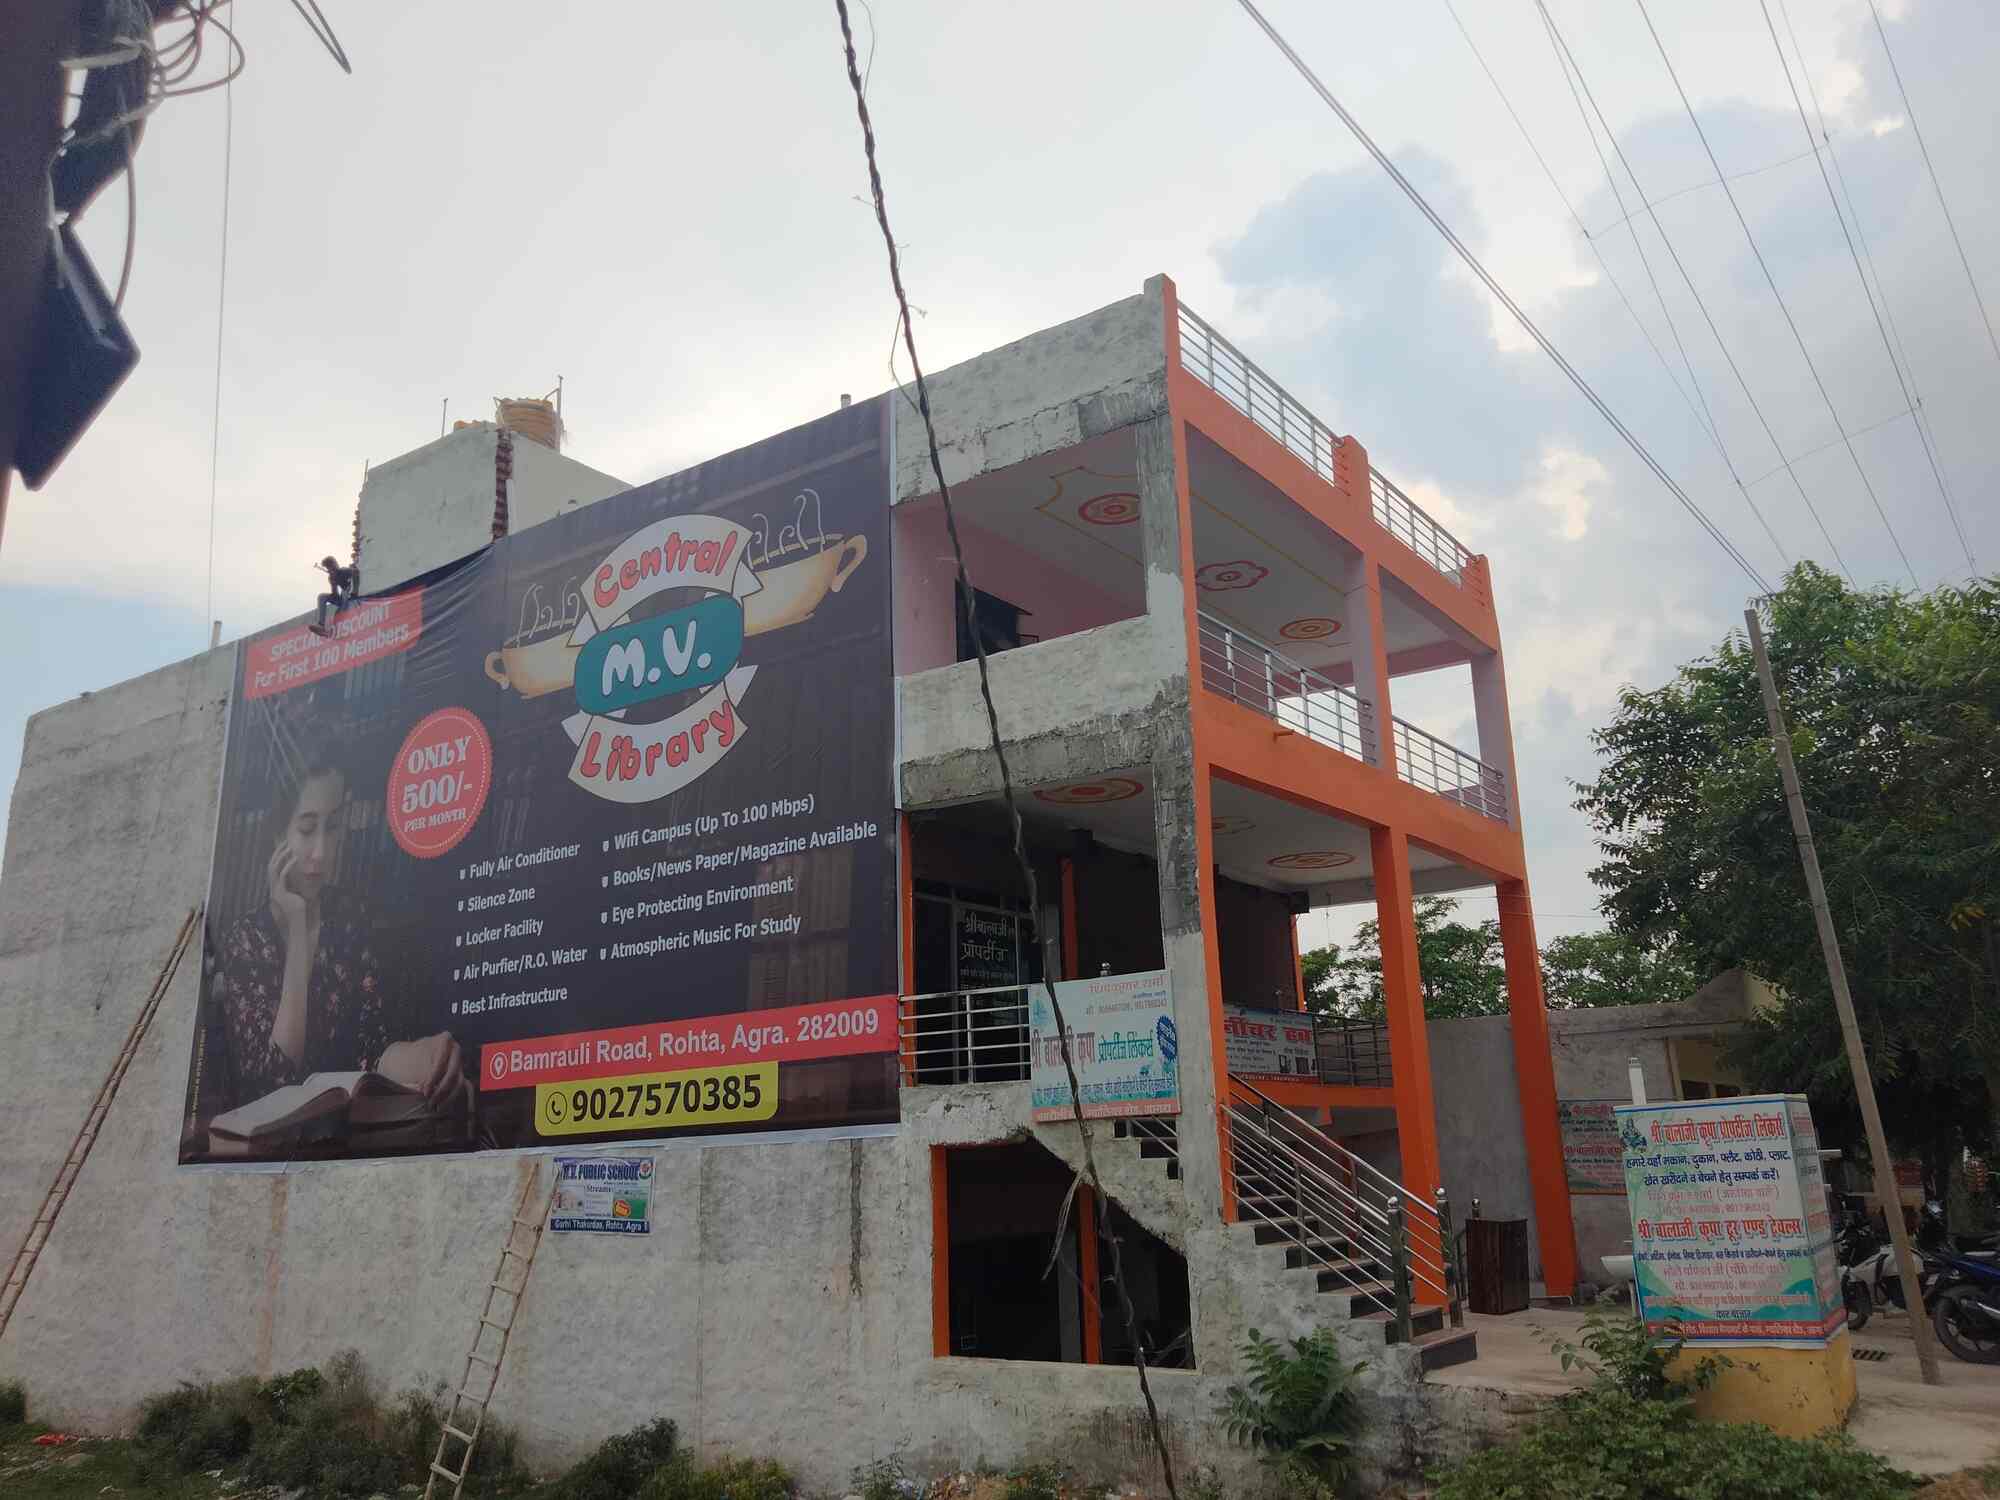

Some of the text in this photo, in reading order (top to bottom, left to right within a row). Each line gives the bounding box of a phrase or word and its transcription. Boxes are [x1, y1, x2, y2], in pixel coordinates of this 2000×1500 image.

[593, 531, 737, 608] Central
[254, 623, 409, 690] For First 100 Members
[602, 620, 712, 696] M.V.
[407, 736, 472, 774] ONLY
[580, 700, 736, 781] Library
[402, 771, 473, 813] 500/-
[404, 808, 467, 833] PER MONTH
[614, 794, 815, 850] Wifi Campus (Up To 100 Mbps)
[469, 843, 581, 880] Fully Air Conditioner
[613, 821, 878, 887] Books/News Paper/Magazine Available
[467, 887, 536, 912] Silence Zone
[612, 876, 795, 925] Eye Protecting Environment
[465, 918, 544, 946] Locker Facility
[610, 914, 801, 960] Atmospheric Music For Study
[463, 965, 480, 981] Air
[551, 947, 588, 966] Water
[461, 986, 568, 1015] Best Infrastructure
[510, 1009, 879, 1073] Bamrauli Road, Rohta, Agra. 282009
[572, 1074, 762, 1122] 9027570385
[1651, 1118, 1662, 1144] श्री
[1664, 1117, 1697, 1143] बालाजी
[1699, 1121, 1717, 1147] कृपा
[578, 1163, 606, 1180] PUBLIC
[607, 1163, 640, 1181] SCHOOL
[1626, 1153, 1645, 1169] हमारे
[1661, 1171, 1689, 1185] खरीदने
[1698, 1170, 1717, 1183] बेचने
[1719, 1170, 1733, 1187] हेतु
[1734, 1168, 1760, 1182] सम्पर्क
[1638, 1219, 1650, 1239] श्री
[1655, 1217, 1696, 1238] बालाजी
[1699, 1221, 1722, 1243] कृपा
